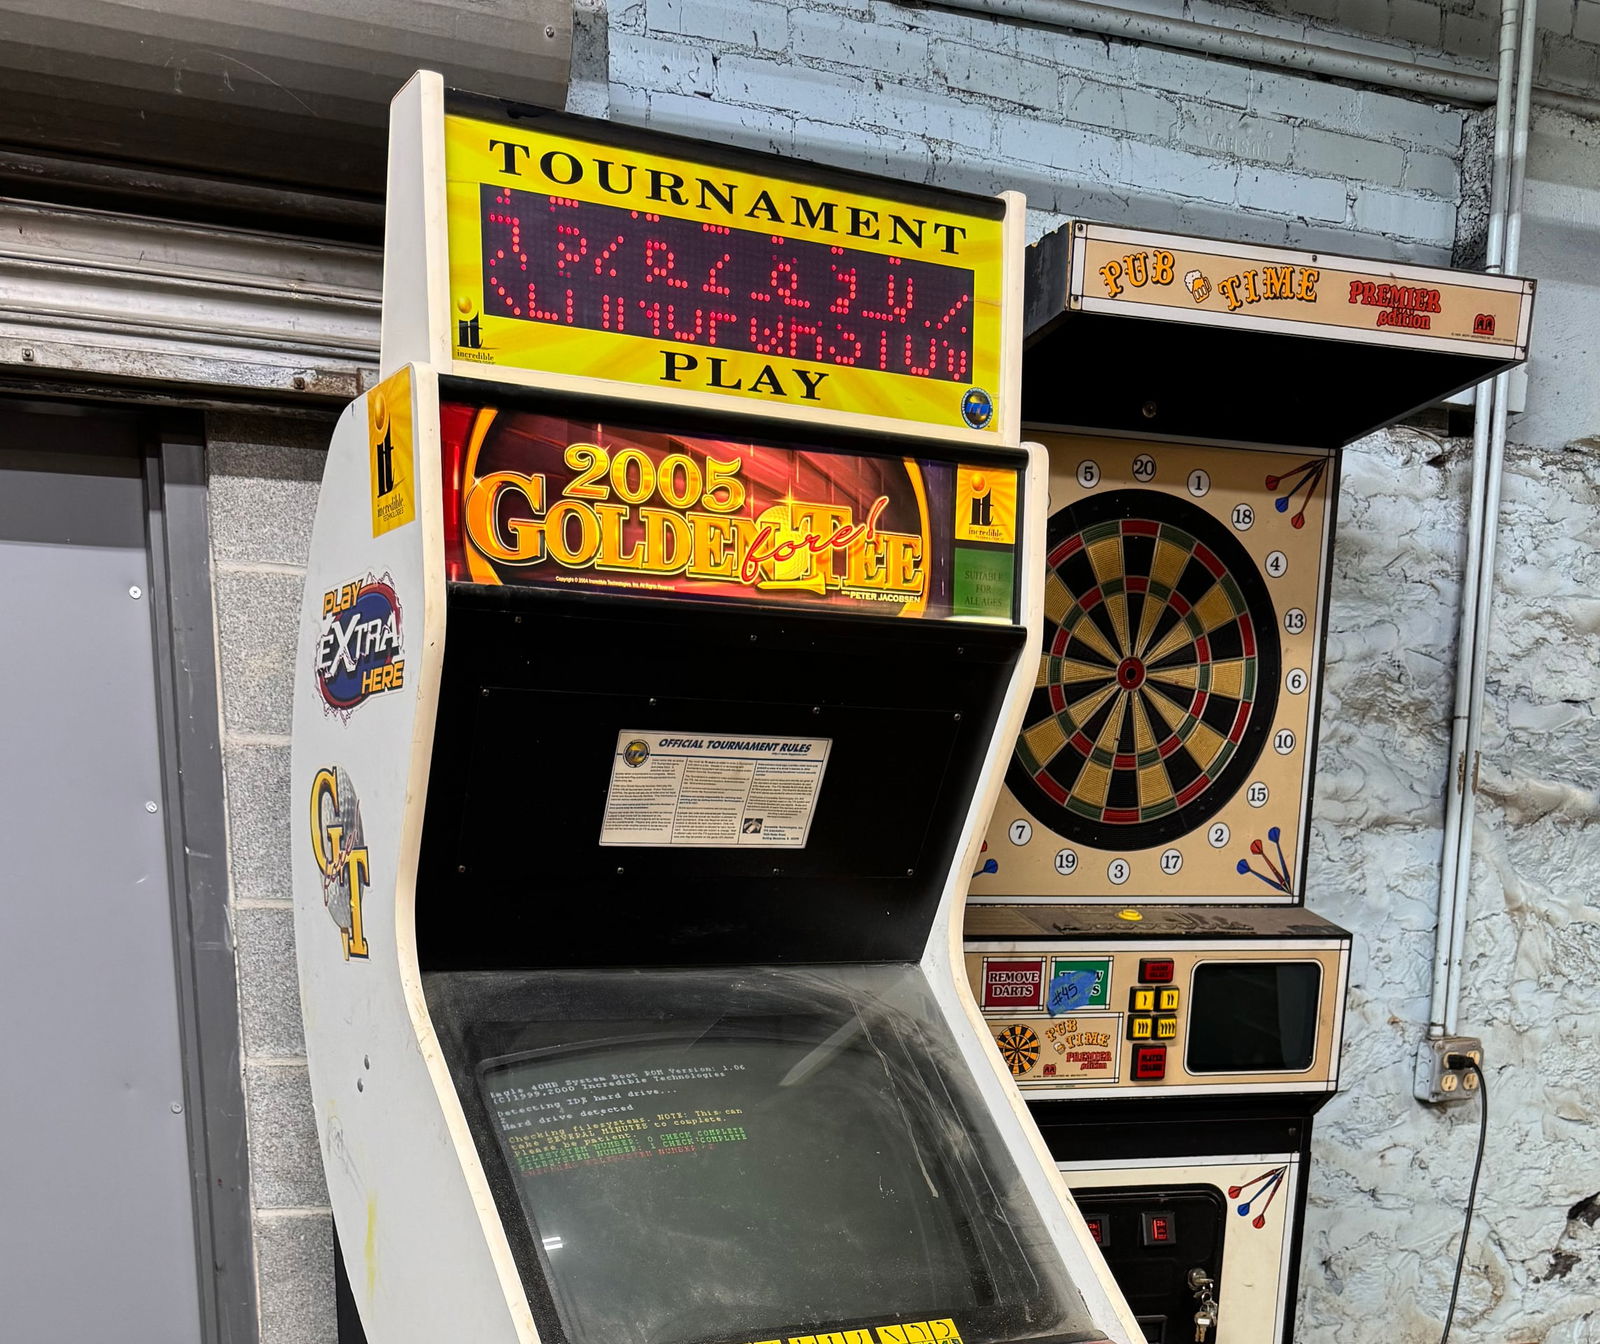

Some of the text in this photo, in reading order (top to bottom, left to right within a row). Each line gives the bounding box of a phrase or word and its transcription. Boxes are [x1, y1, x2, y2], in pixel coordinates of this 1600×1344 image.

[489, 139, 967, 255] TOURNAMENT
[1099, 249, 1321, 312] PUB TIME
[1348, 279, 1441, 314] PREMIER
[1376, 310, 1431, 331] edition
[457, 349, 494, 361] incredible
[659, 350, 830, 402] PLAY
[1084, 465, 1093, 482] 5
[1134, 459, 1155, 476] 20
[563, 442, 746, 513] 2005
[1195, 475, 1203, 491] 1
[1234, 508, 1253, 525] 18
[466, 470, 925, 595] GOLDEN TEE
[739, 496, 890, 584] fore!
[968, 526, 1003, 538] incredible
[1270, 555, 1281, 572] 4
[964, 569, 1002, 582] SUITABLE
[850, 591, 921, 603] PETER JACOBSEN
[976, 584, 993, 595] FOR
[322, 578, 364, 620] PLAY
[964, 596, 1003, 608] ALL AGES
[1286, 612, 1304, 629] 13
[361, 660, 405, 695] HERE
[1291, 674, 1302, 689] 6
[658, 738, 813, 754] OFFICIAL TOURNAMENT RULES
[1275, 733, 1295, 750] 10
[1248, 787, 1267, 802] 15
[1015, 824, 1025, 841] 7
[1213, 827, 1225, 842] 2
[1056, 853, 1076, 870] 19
[1162, 854, 1181, 869] 17
[1113, 864, 1124, 880] 3
[988, 970, 1040, 984] REMOVE
[992, 984, 1034, 998] DARTS
[1051, 983, 1079, 1006] #45
[1045, 1018, 1079, 1042] PUB
[1064, 1031, 1112, 1049] TIME
[1065, 1050, 1112, 1063] PREMIER
[565, 1076, 607, 1087] System
[611, 1072, 638, 1080] Boot
[581, 1078, 647, 1090] Incredible
[653, 1071, 727, 1083] Technologies
[497, 1102, 561, 1118] Detecting
[593, 1092, 622, 1102] hard
[502, 1104, 635, 1131] Hard drive detected
[508, 1128, 566, 1144] Checking
[695, 1110, 721, 1118] This
[725, 1108, 743, 1116] can
[511, 1140, 540, 1151] take
[601, 1123, 649, 1136] MINUTES
[654, 1121, 668, 1129] to
[563, 1141, 578, 1149] be
